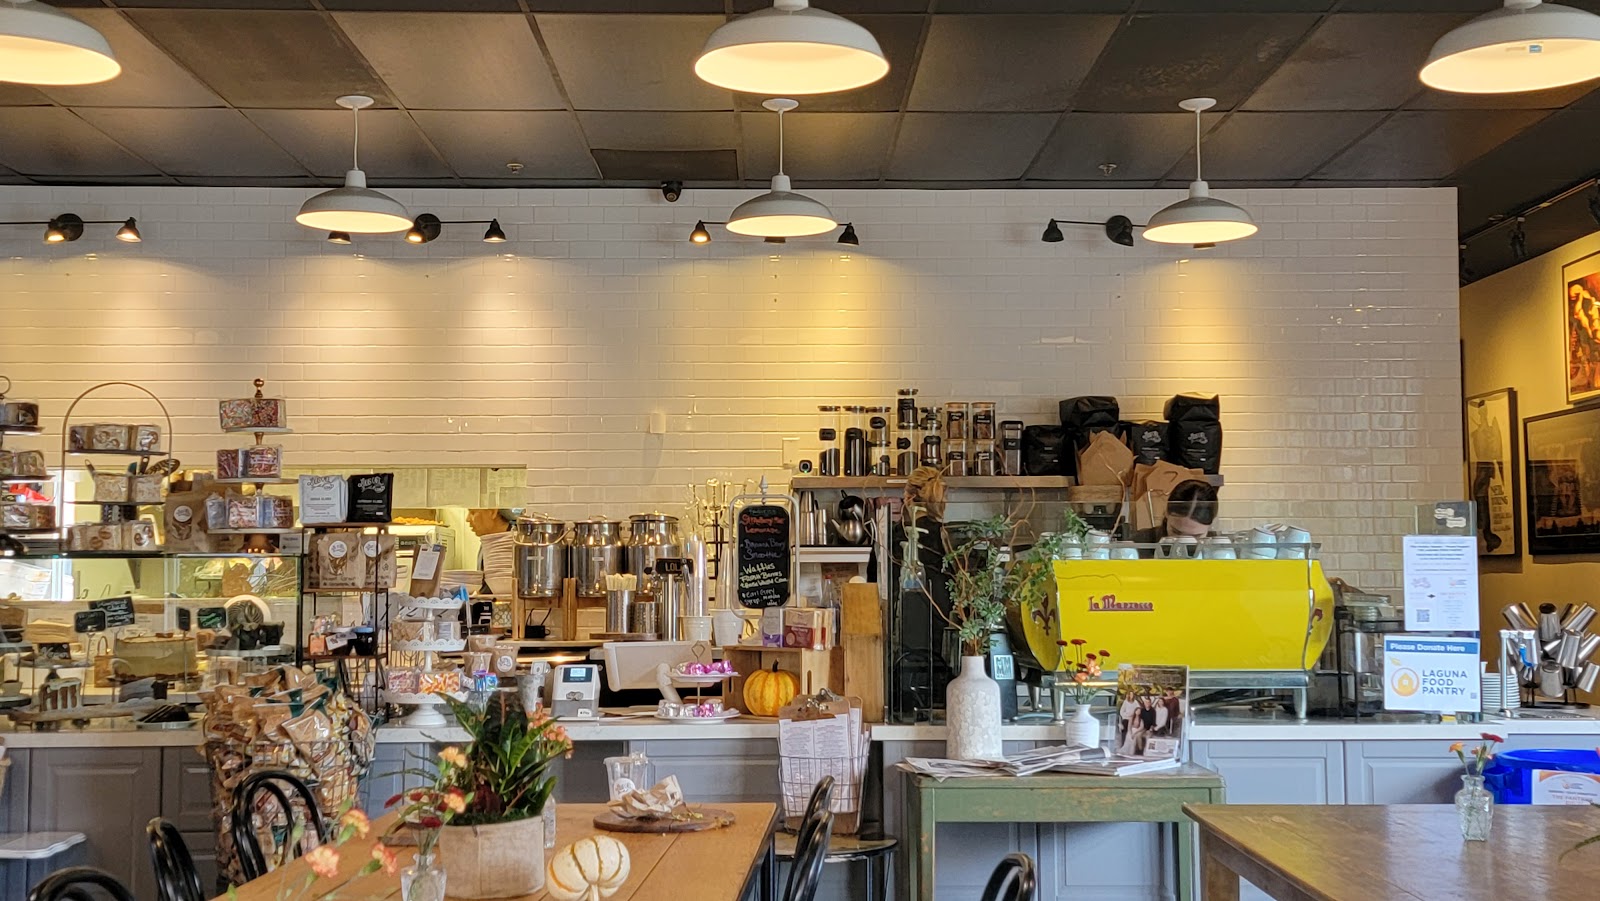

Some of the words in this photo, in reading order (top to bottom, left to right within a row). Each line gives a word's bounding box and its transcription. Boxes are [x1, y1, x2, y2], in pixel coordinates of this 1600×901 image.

[1390, 642, 1416, 651] Please
[1416, 643, 1445, 652] Donate
[1422, 669, 1468, 678] LAGUNA
[1422, 678, 1454, 686] FOOD
[1422, 686, 1466, 695] PANTRY
